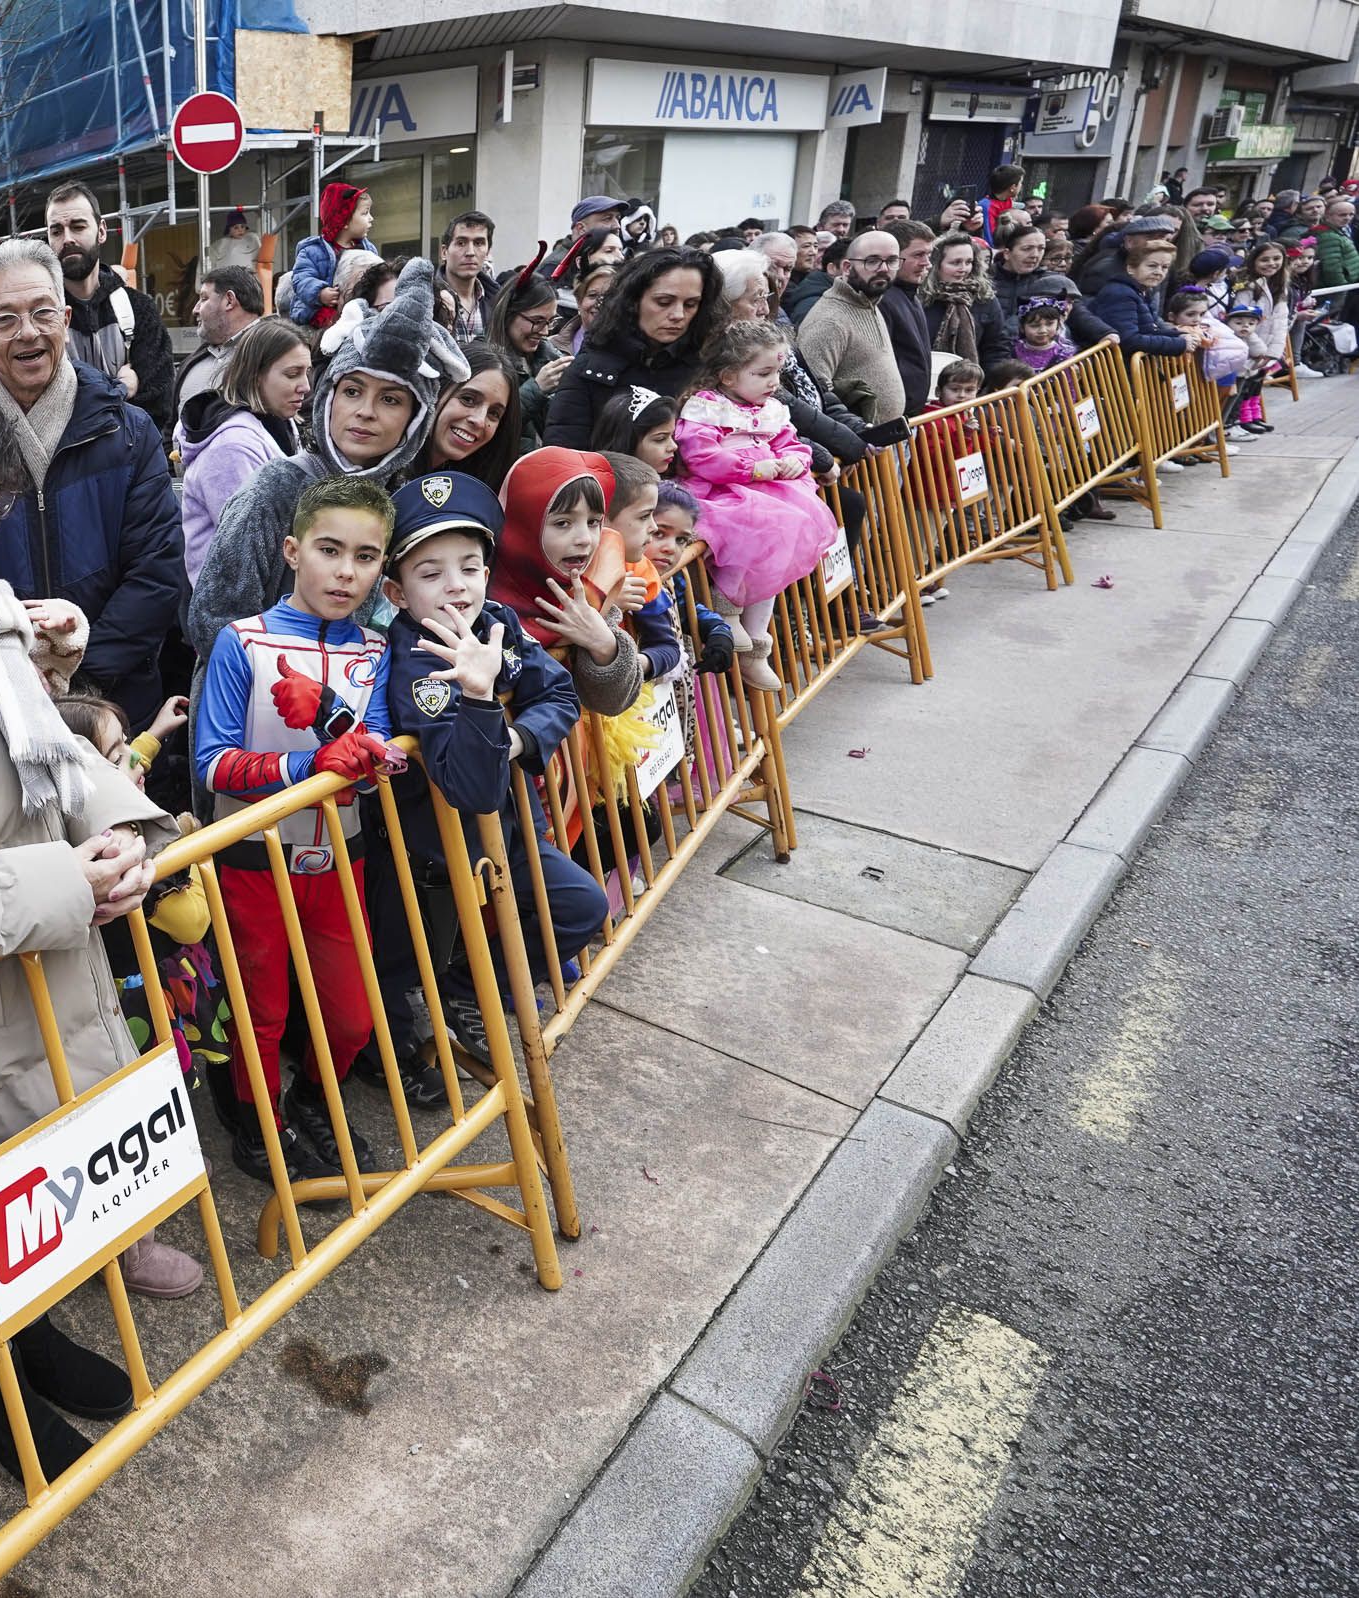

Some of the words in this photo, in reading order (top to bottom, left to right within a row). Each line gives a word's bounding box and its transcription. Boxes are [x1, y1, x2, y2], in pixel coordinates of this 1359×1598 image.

[666, 71, 779, 122] ABANCA
[652, 692, 676, 732] agal
[91, 1158, 170, 1222] ALQUILER
